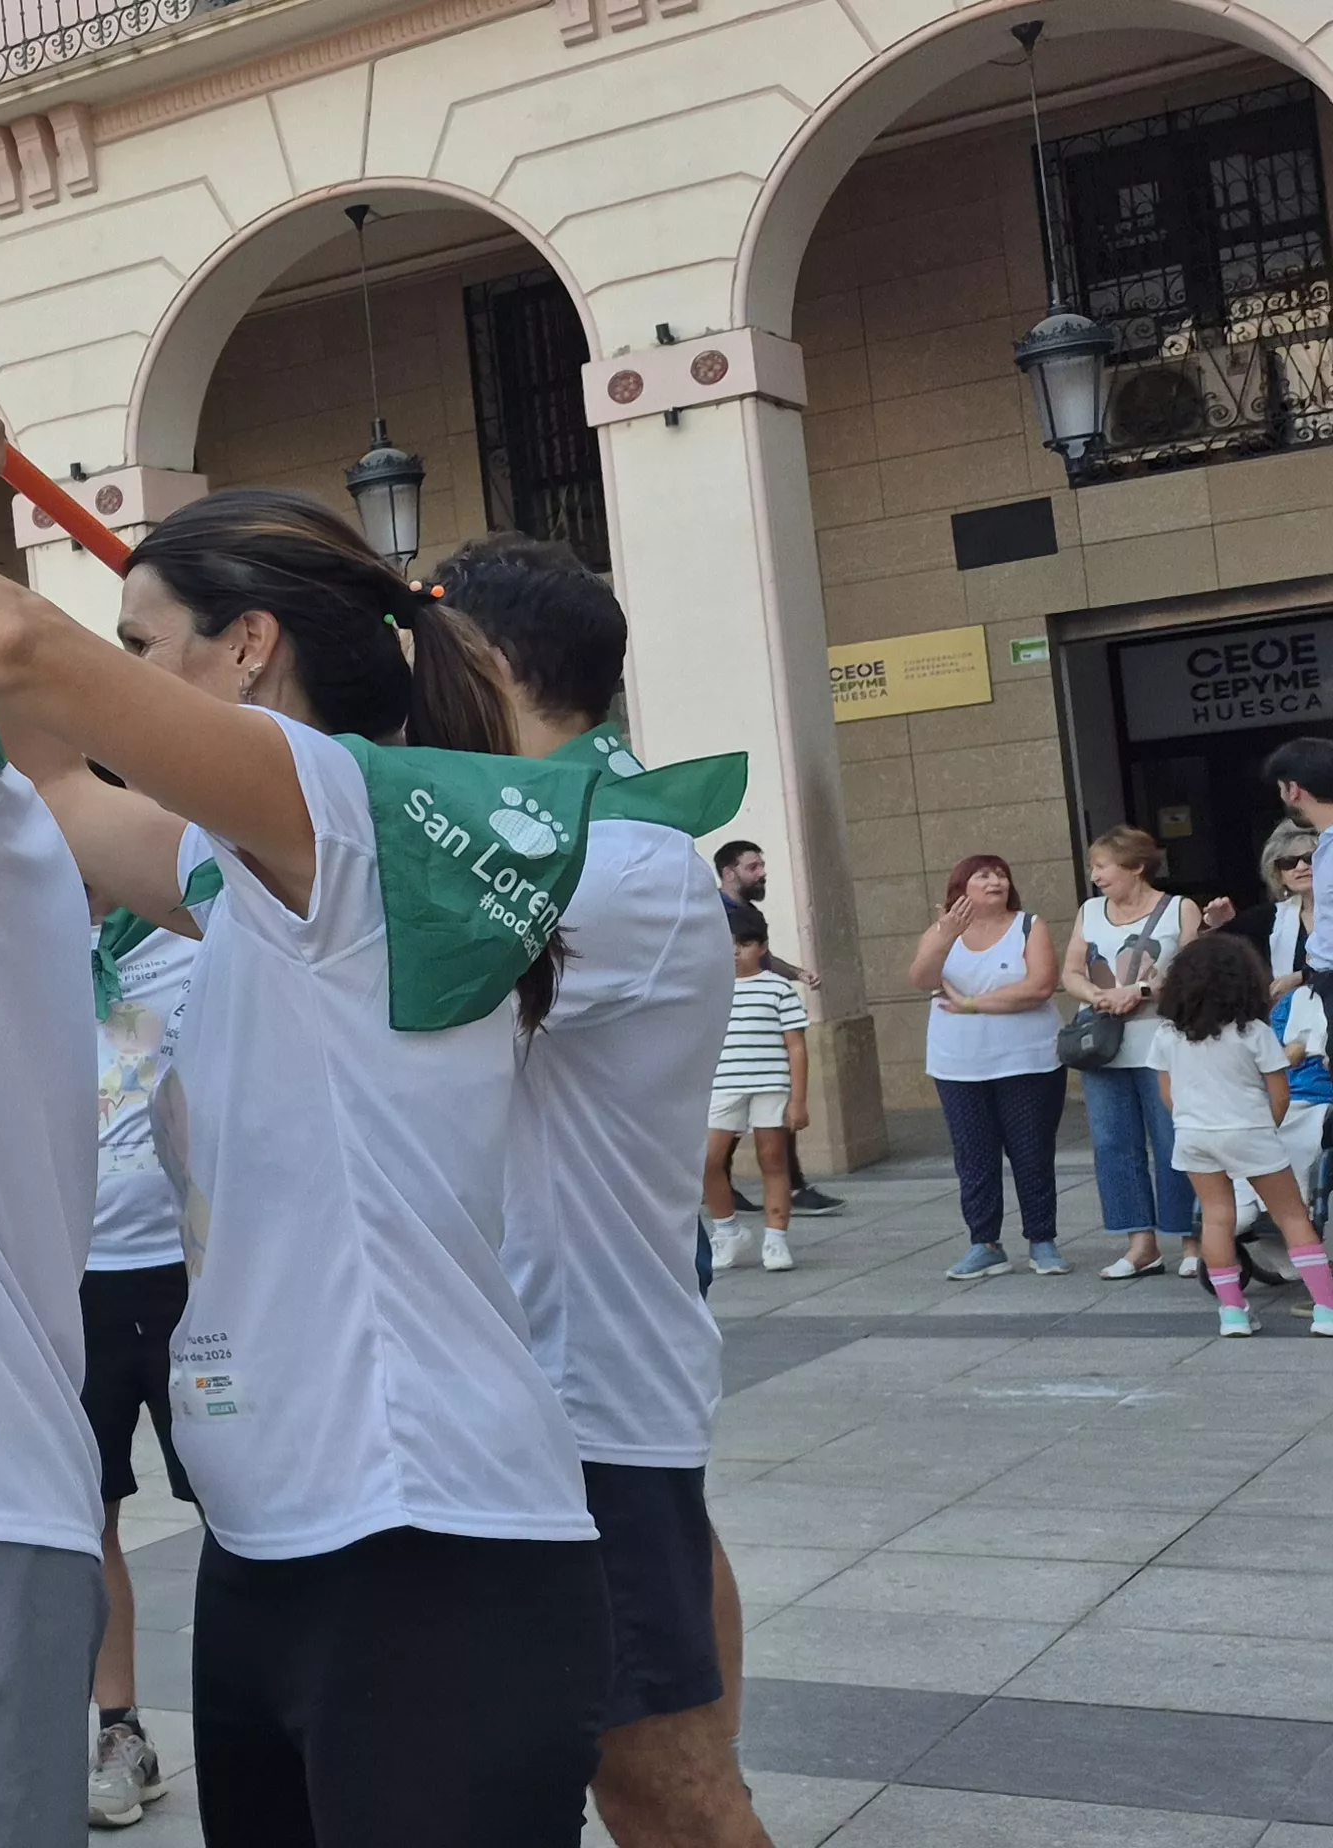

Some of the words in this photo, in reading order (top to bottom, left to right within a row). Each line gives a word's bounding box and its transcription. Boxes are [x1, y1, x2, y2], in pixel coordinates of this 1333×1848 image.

[829, 660, 886, 682] CEOE
[1187, 632, 1318, 679] CEOE
[1190, 668, 1320, 703] CEPYME
[1193, 692, 1323, 724] HUESCA
[403, 788, 472, 858] San
[187, 1331, 229, 1345] uesca
[204, 1348, 233, 1361] 2026
